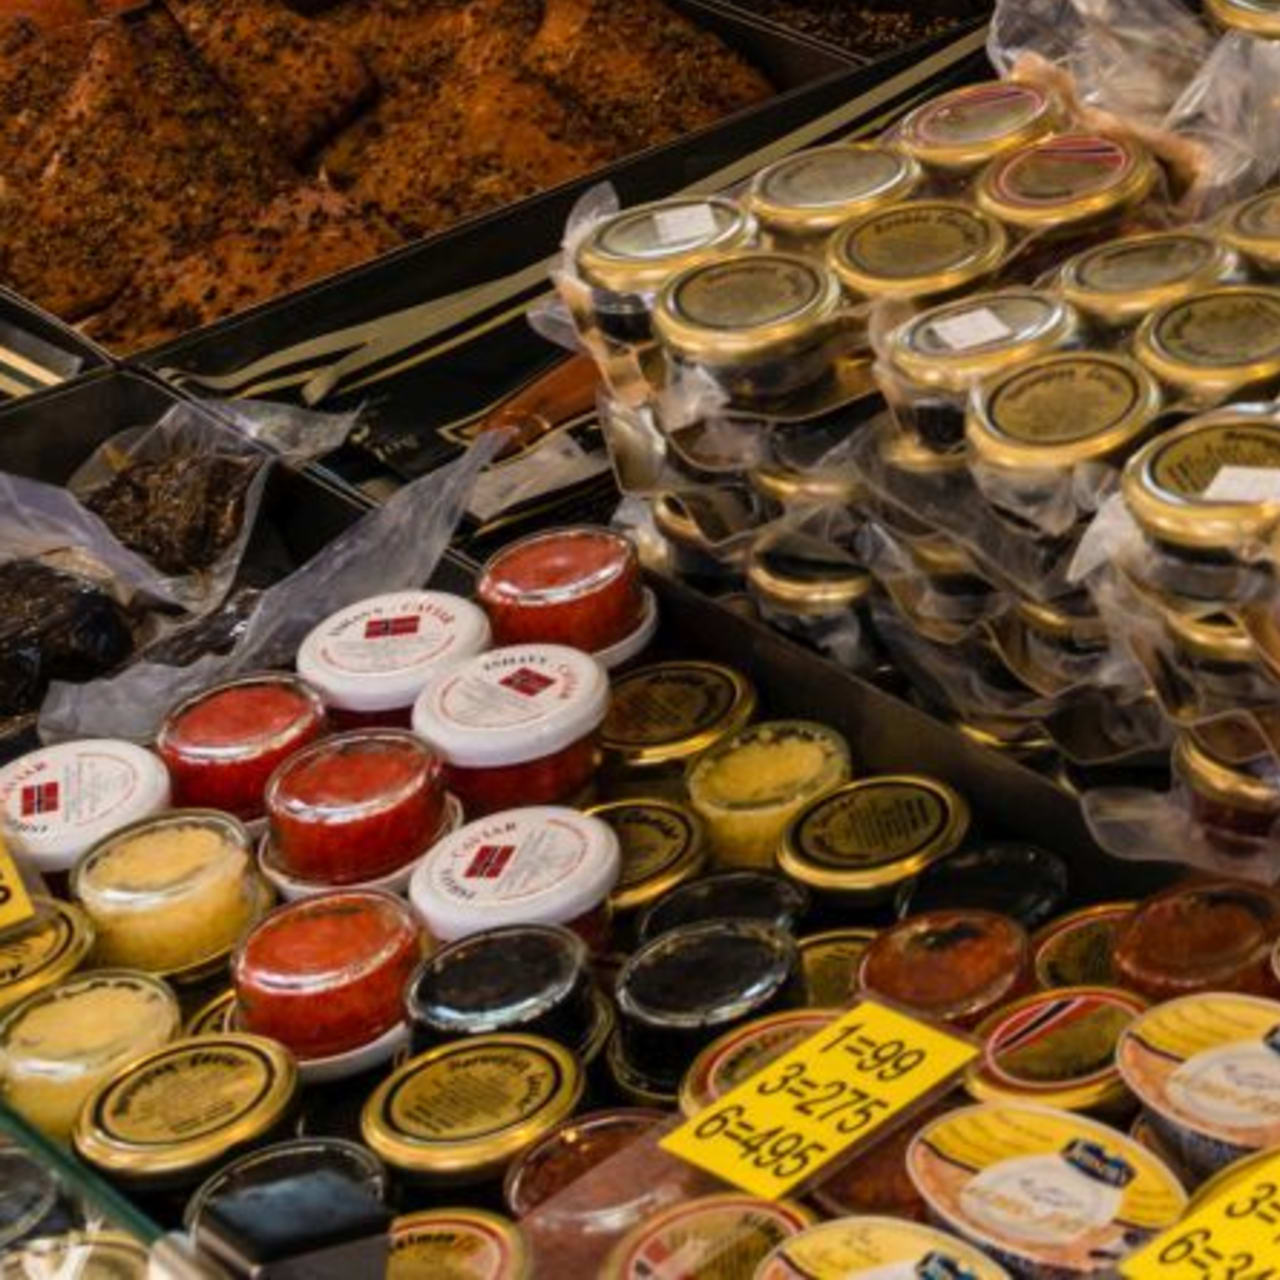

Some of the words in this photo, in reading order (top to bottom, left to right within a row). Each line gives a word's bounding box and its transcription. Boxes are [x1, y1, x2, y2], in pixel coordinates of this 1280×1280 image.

[819, 1022, 926, 1082] 1=99
[756, 1063, 890, 1134] 3=275
[694, 1104, 828, 1179] 6=495
